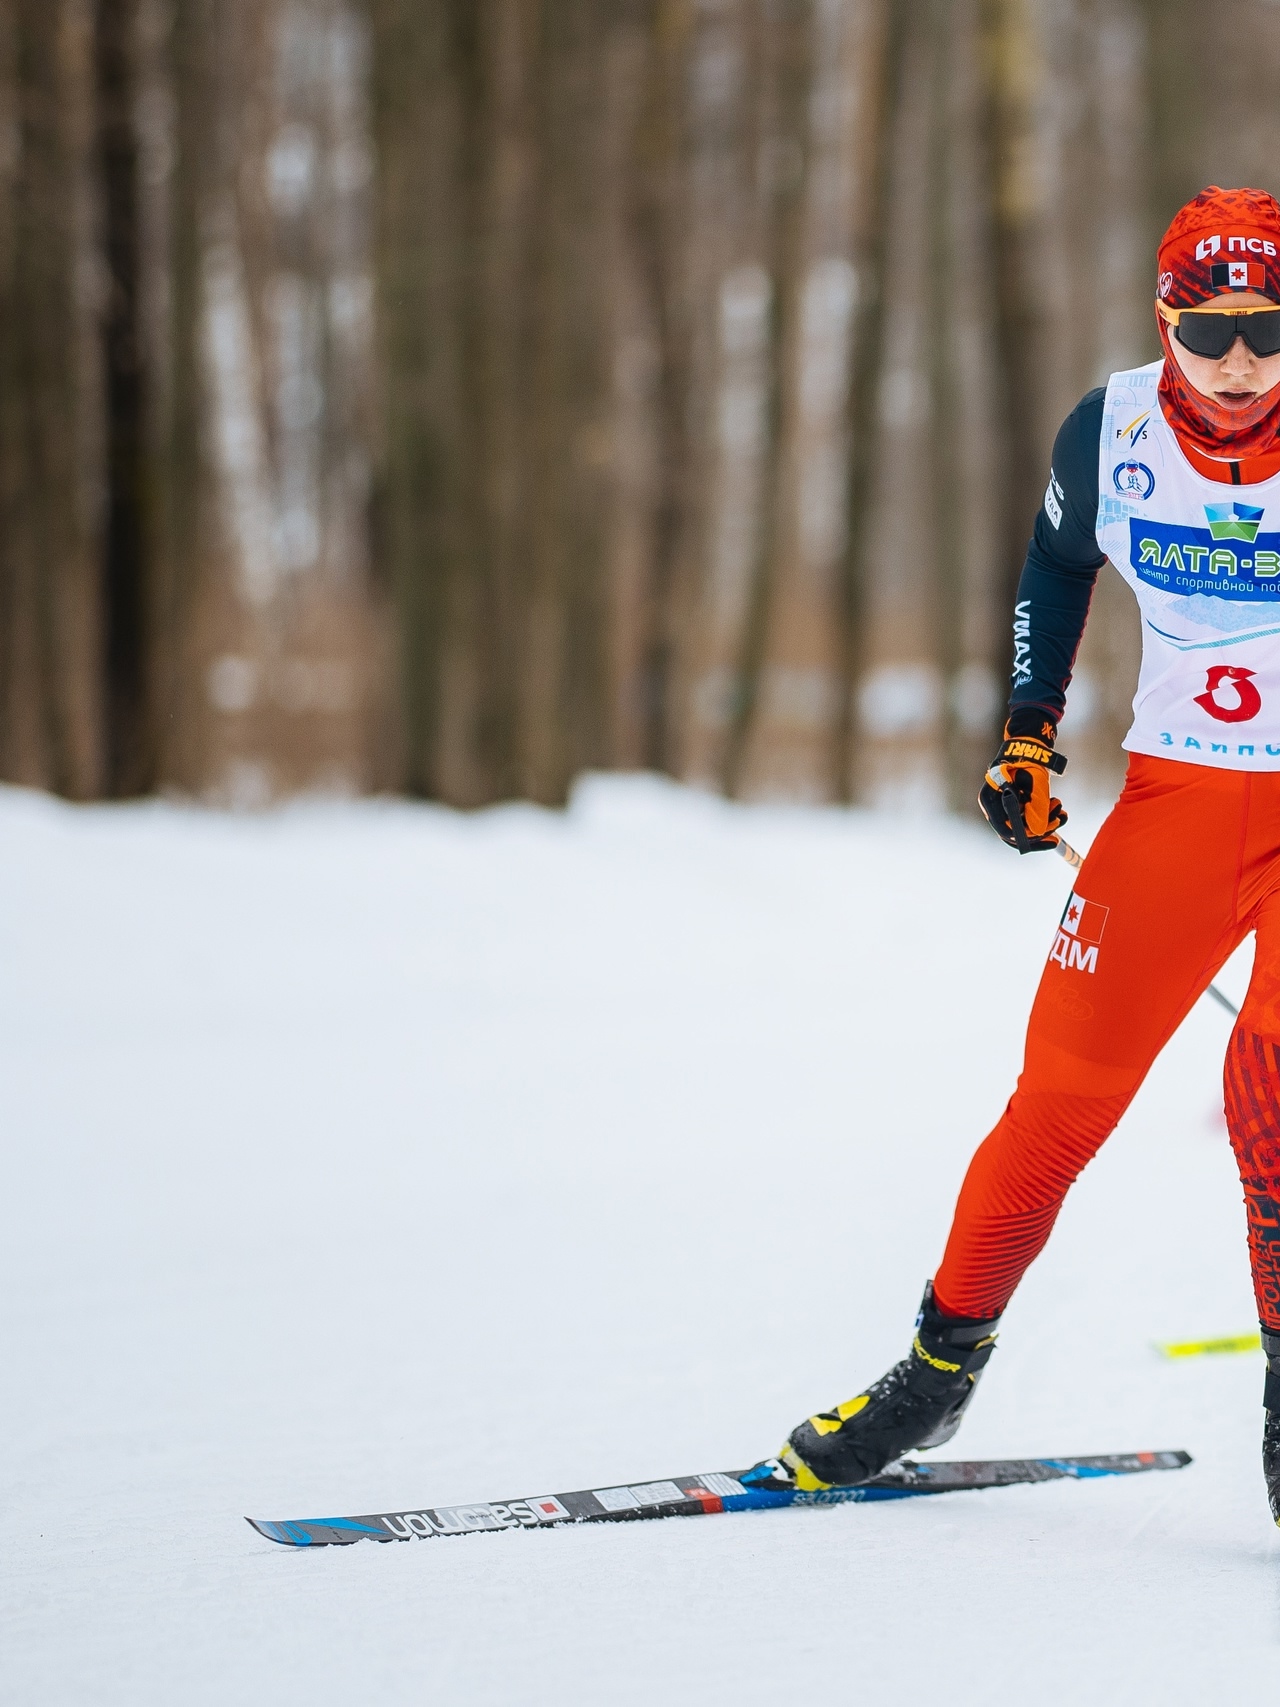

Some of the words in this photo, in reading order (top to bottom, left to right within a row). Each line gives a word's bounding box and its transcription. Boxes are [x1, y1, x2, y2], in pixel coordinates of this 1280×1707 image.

[1228, 236, 1277, 257] ПСБ
[1176, 576, 1254, 593] спортивной
[1012, 600, 1031, 677] VMAX
[1049, 929, 1099, 974] ДМ
